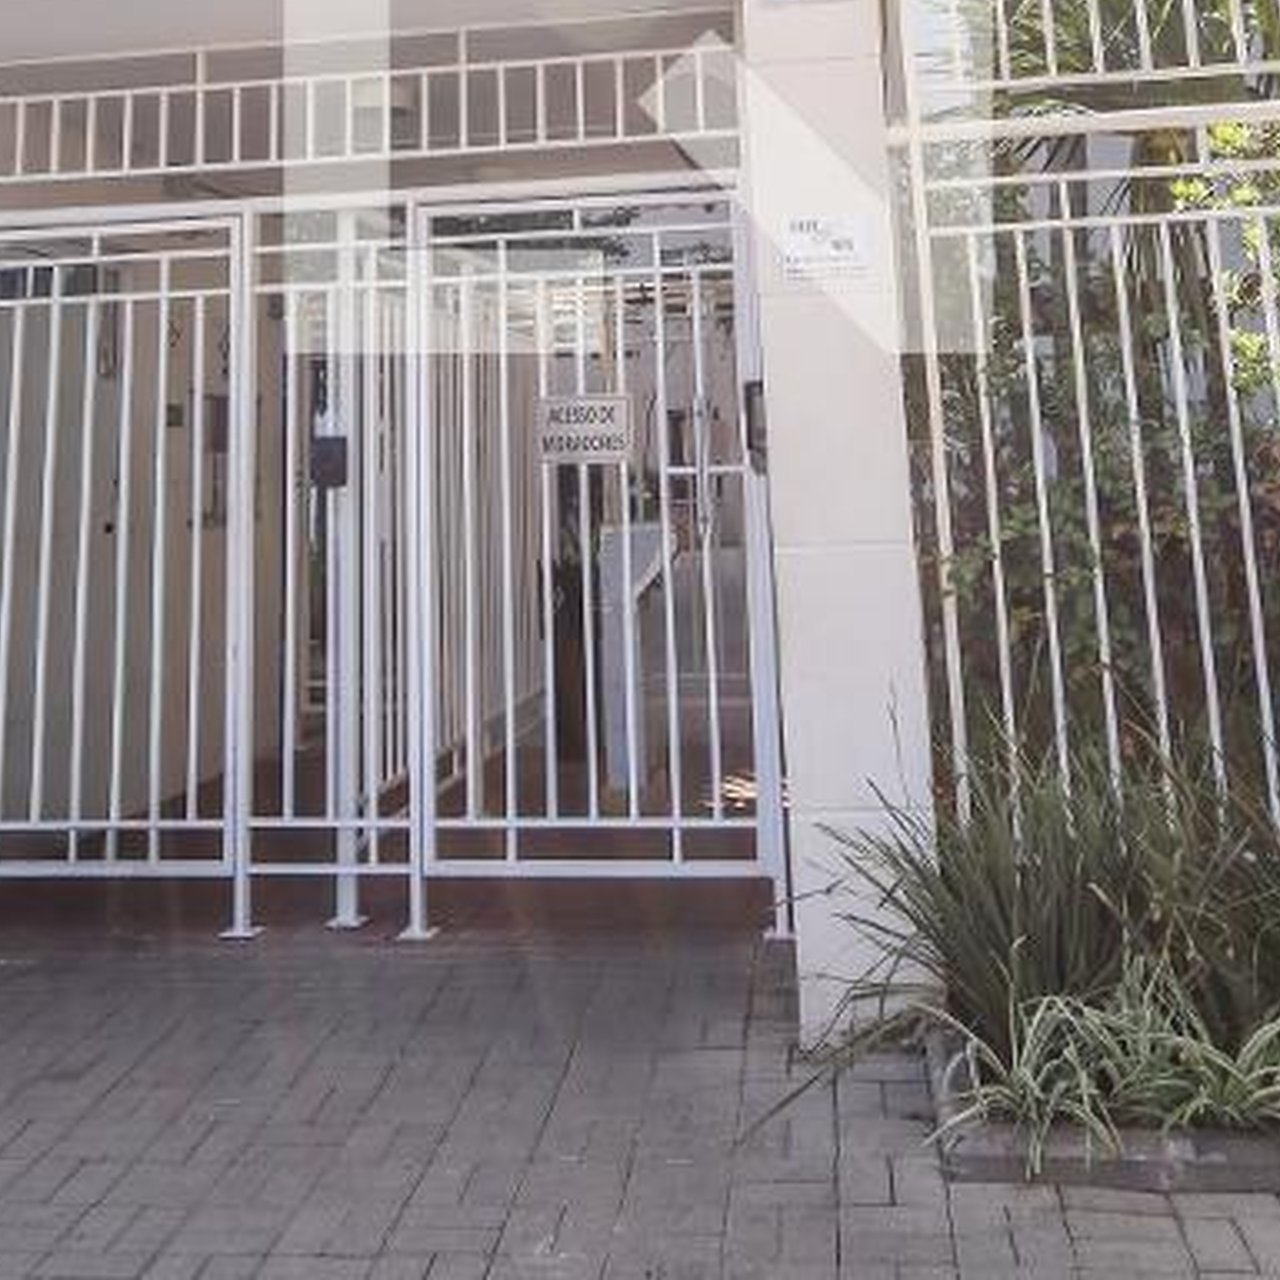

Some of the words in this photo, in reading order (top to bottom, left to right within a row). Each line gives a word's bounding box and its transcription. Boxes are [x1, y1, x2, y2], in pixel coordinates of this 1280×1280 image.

[548, 405, 598, 425] ACESSO
[600, 405, 616, 424] DE
[542, 434, 626, 452] MORADORES
